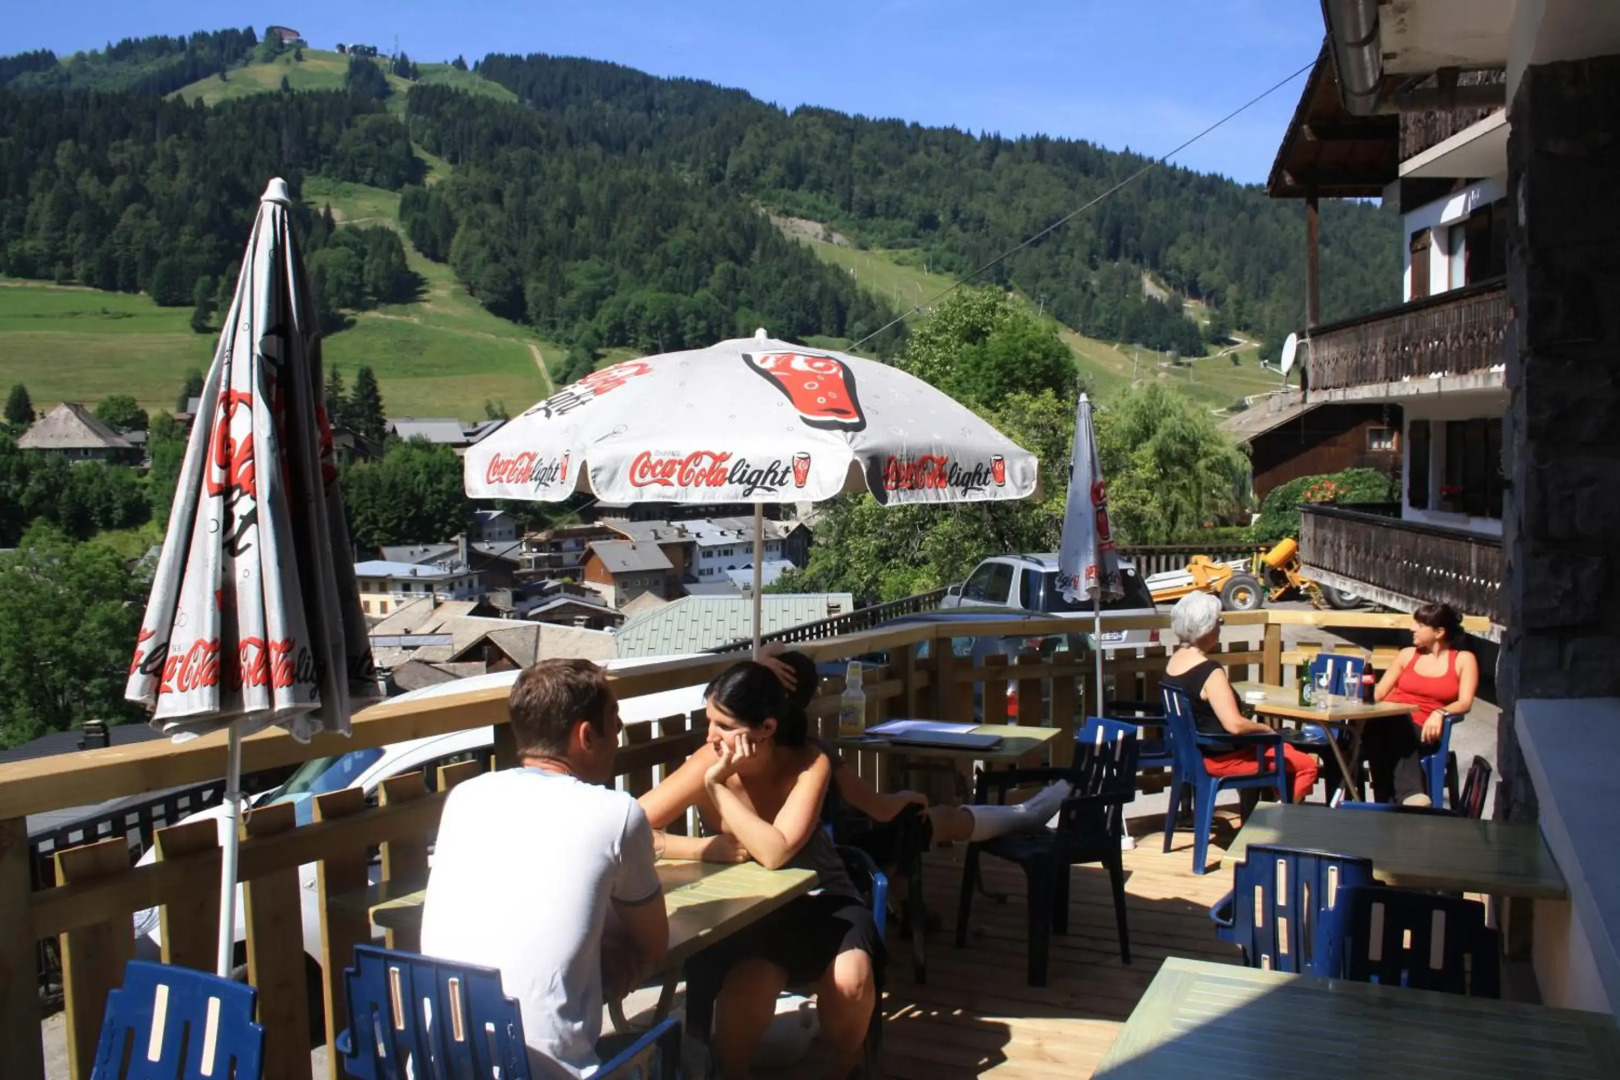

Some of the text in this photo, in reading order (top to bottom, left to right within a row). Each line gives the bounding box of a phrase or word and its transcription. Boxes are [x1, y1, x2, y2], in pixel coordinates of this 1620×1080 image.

[530, 457, 560, 493] light
[629, 450, 793, 498] Coca-Cola light
[947, 462, 991, 498] light
